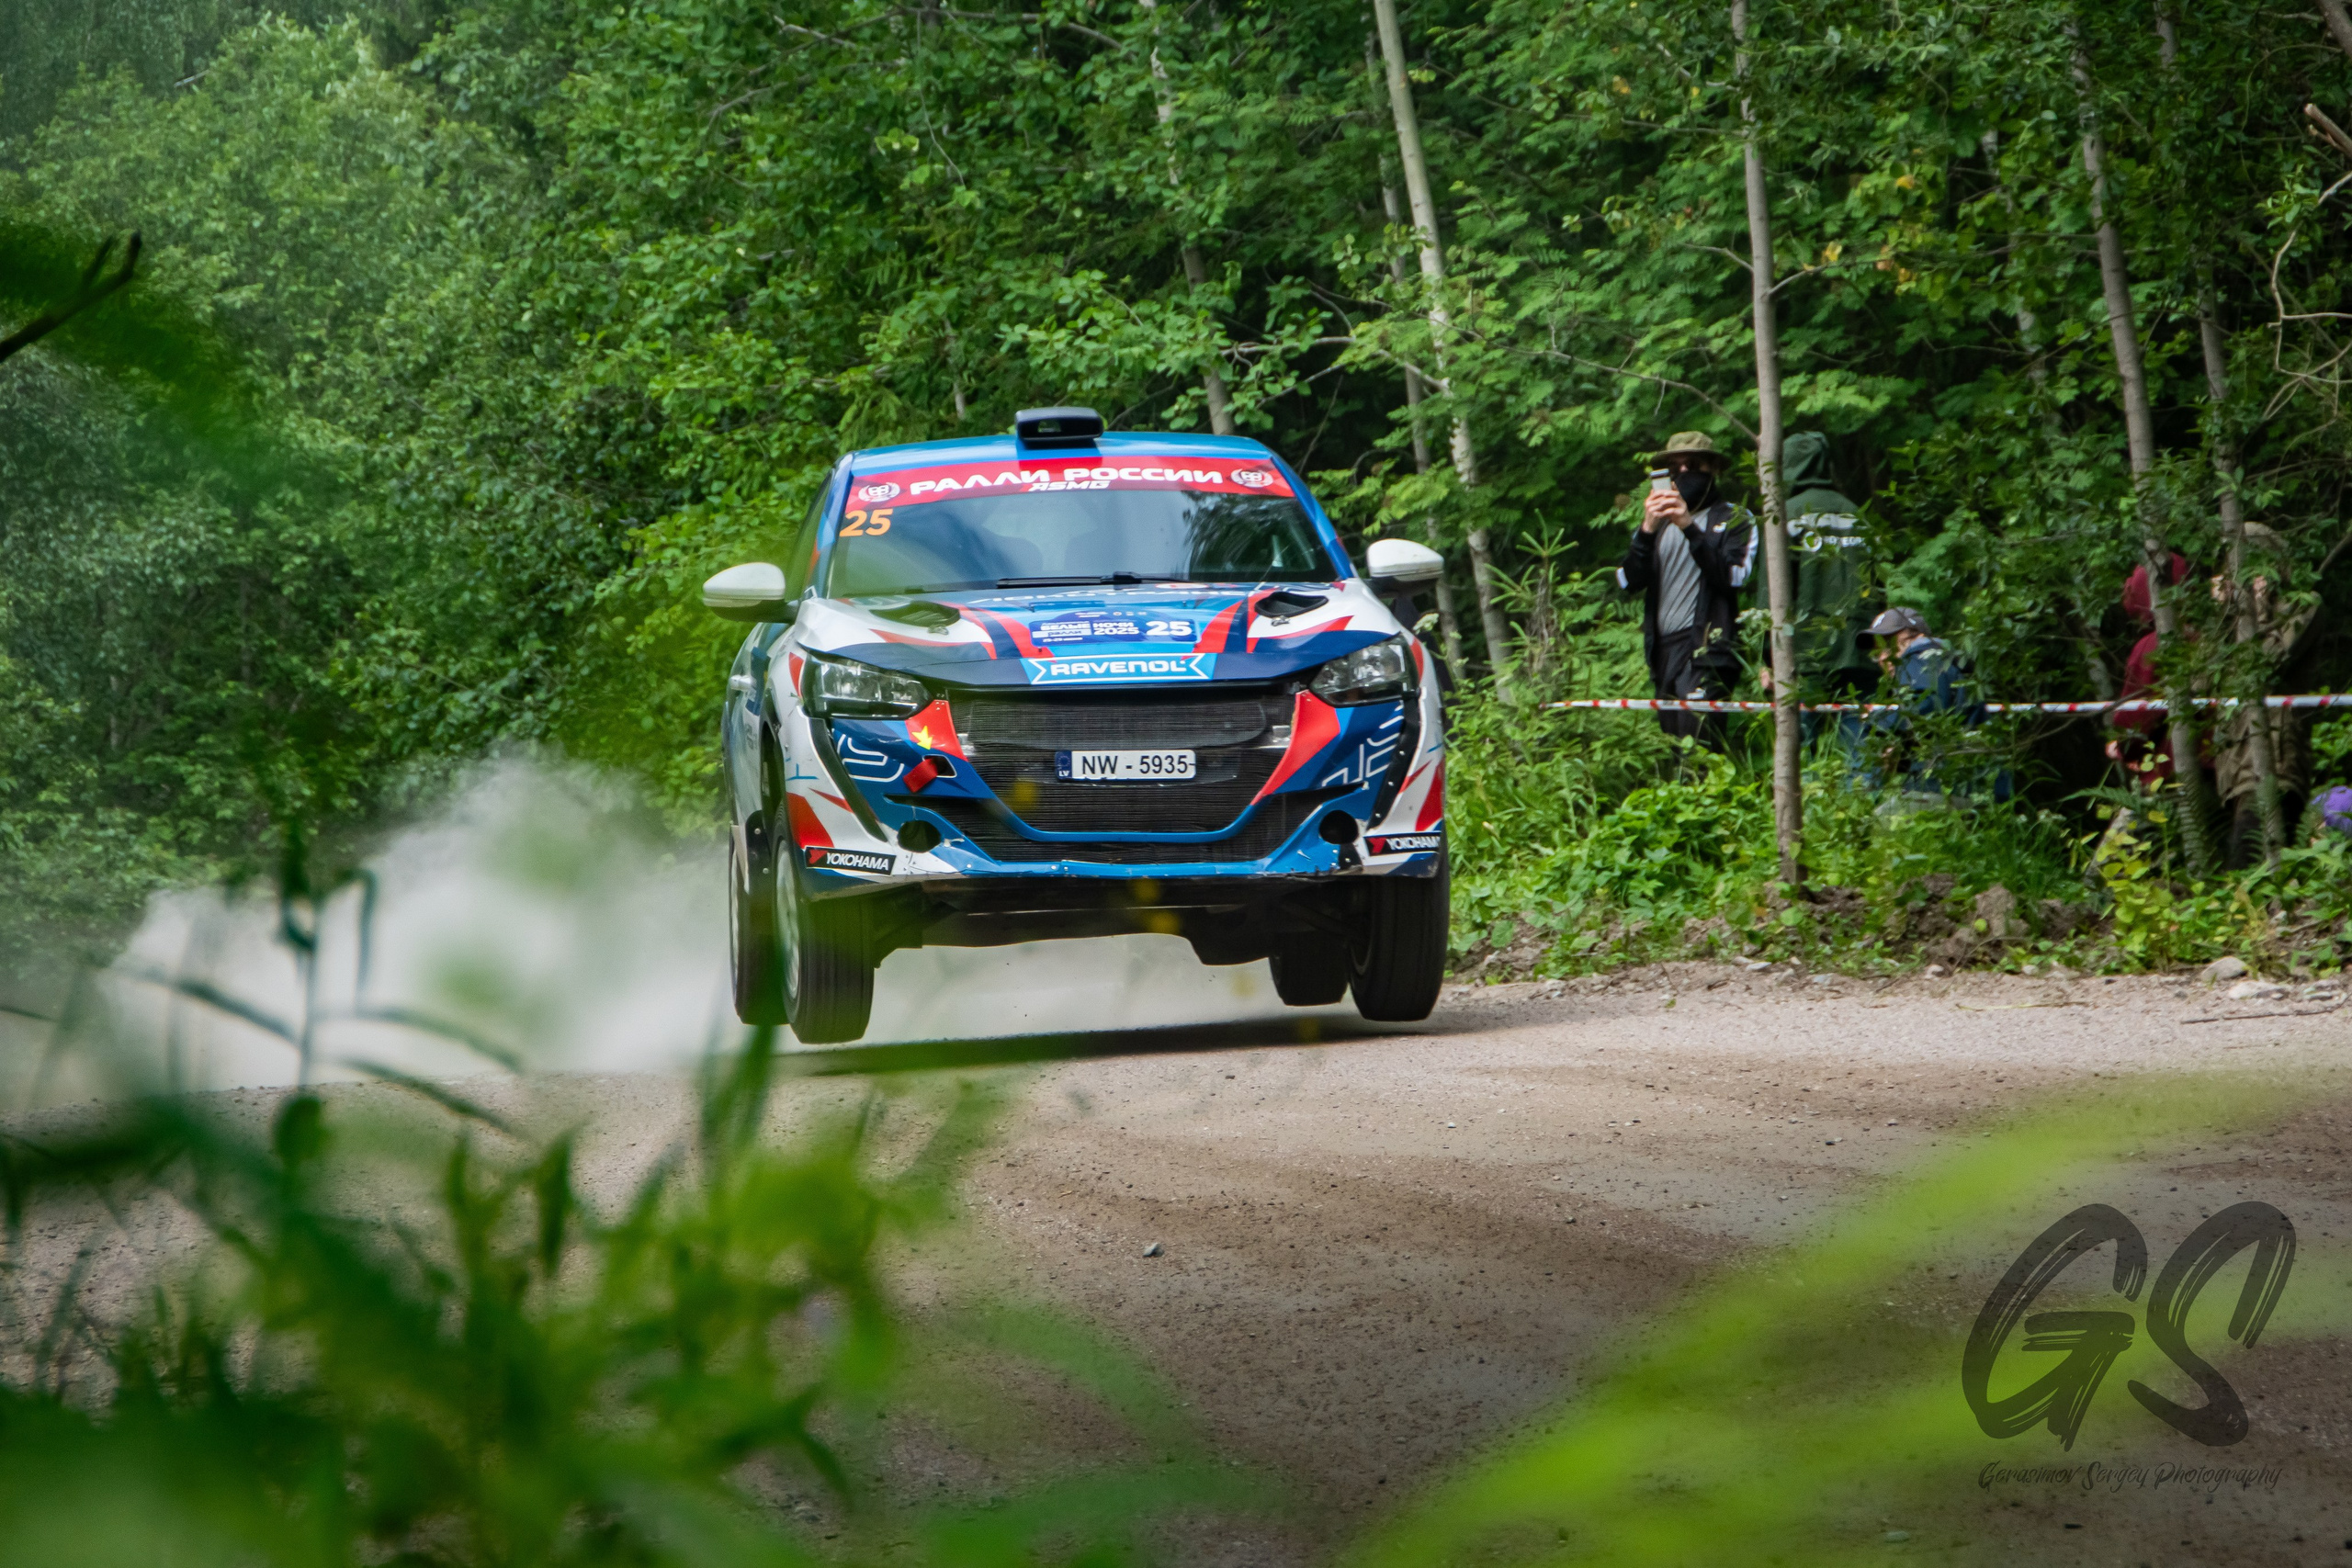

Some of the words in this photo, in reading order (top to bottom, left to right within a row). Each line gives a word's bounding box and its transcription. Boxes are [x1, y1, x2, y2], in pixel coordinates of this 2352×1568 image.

[910, 469, 1050, 495] РАЛЛИ
[1063, 467, 1224, 484] РОССИИ
[839, 508, 894, 537] 25
[1093, 626, 1140, 636] 2025
[1146, 620, 1193, 637] 25
[1050, 660, 1187, 676] RAVENOL
[1082, 755, 1118, 774] NW
[1139, 755, 1188, 774] 5935
[826, 852, 889, 871] YOKOHAMA
